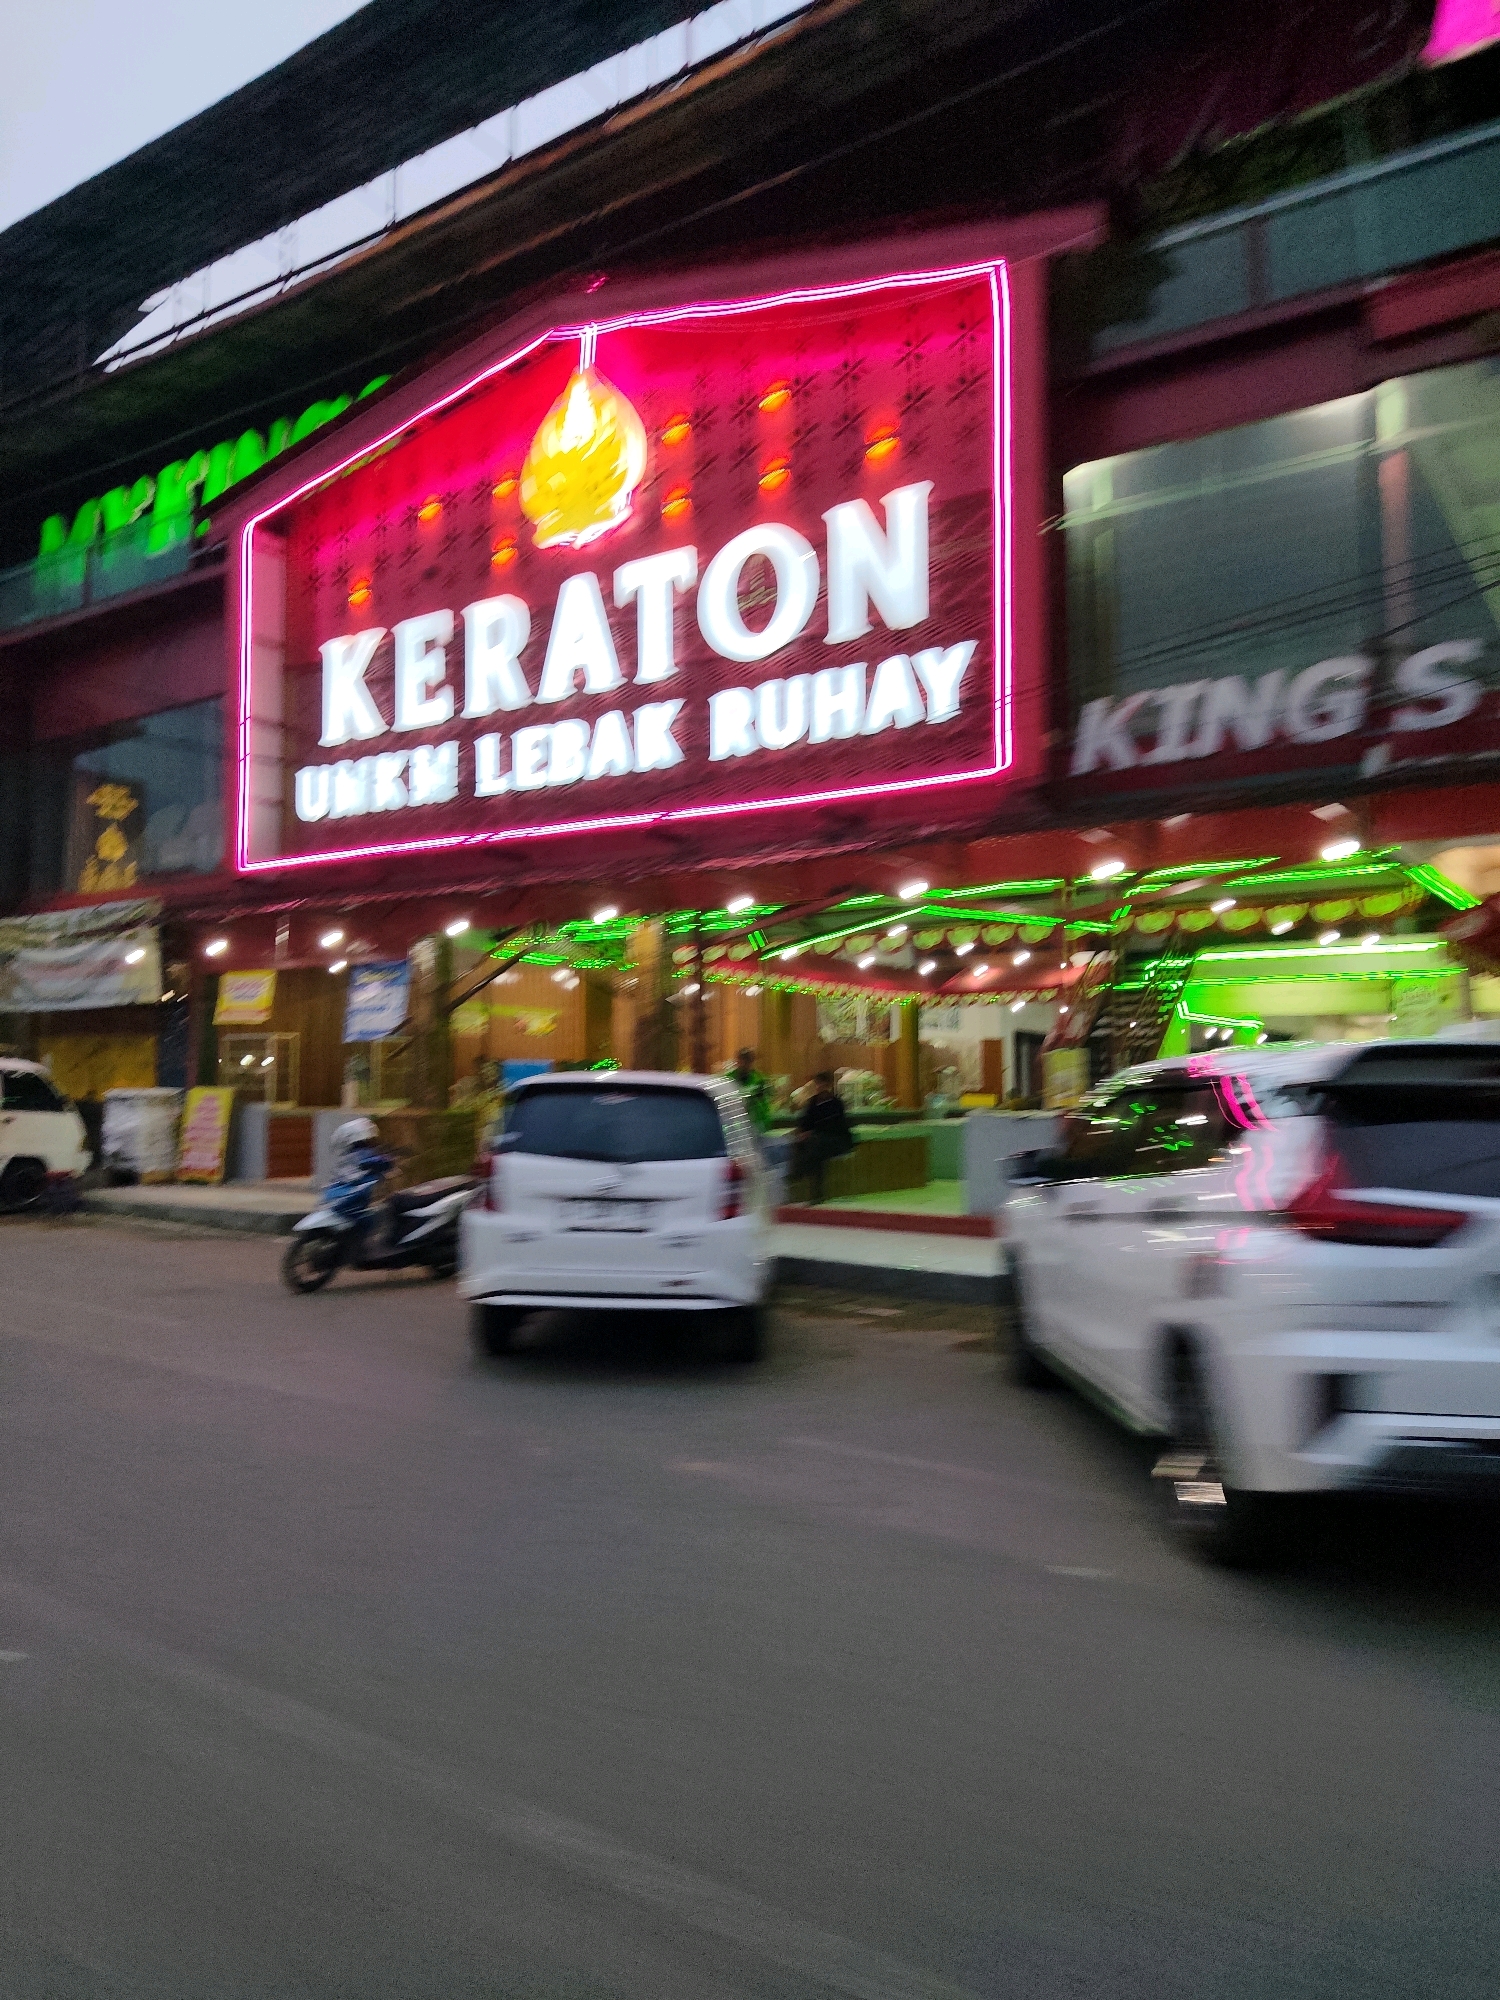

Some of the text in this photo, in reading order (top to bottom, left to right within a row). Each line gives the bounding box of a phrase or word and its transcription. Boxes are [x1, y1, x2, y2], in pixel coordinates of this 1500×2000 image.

[317, 480, 935, 748] KERATON
[473, 698, 686, 798] LEBAK
[707, 639, 979, 762] RUHAY
